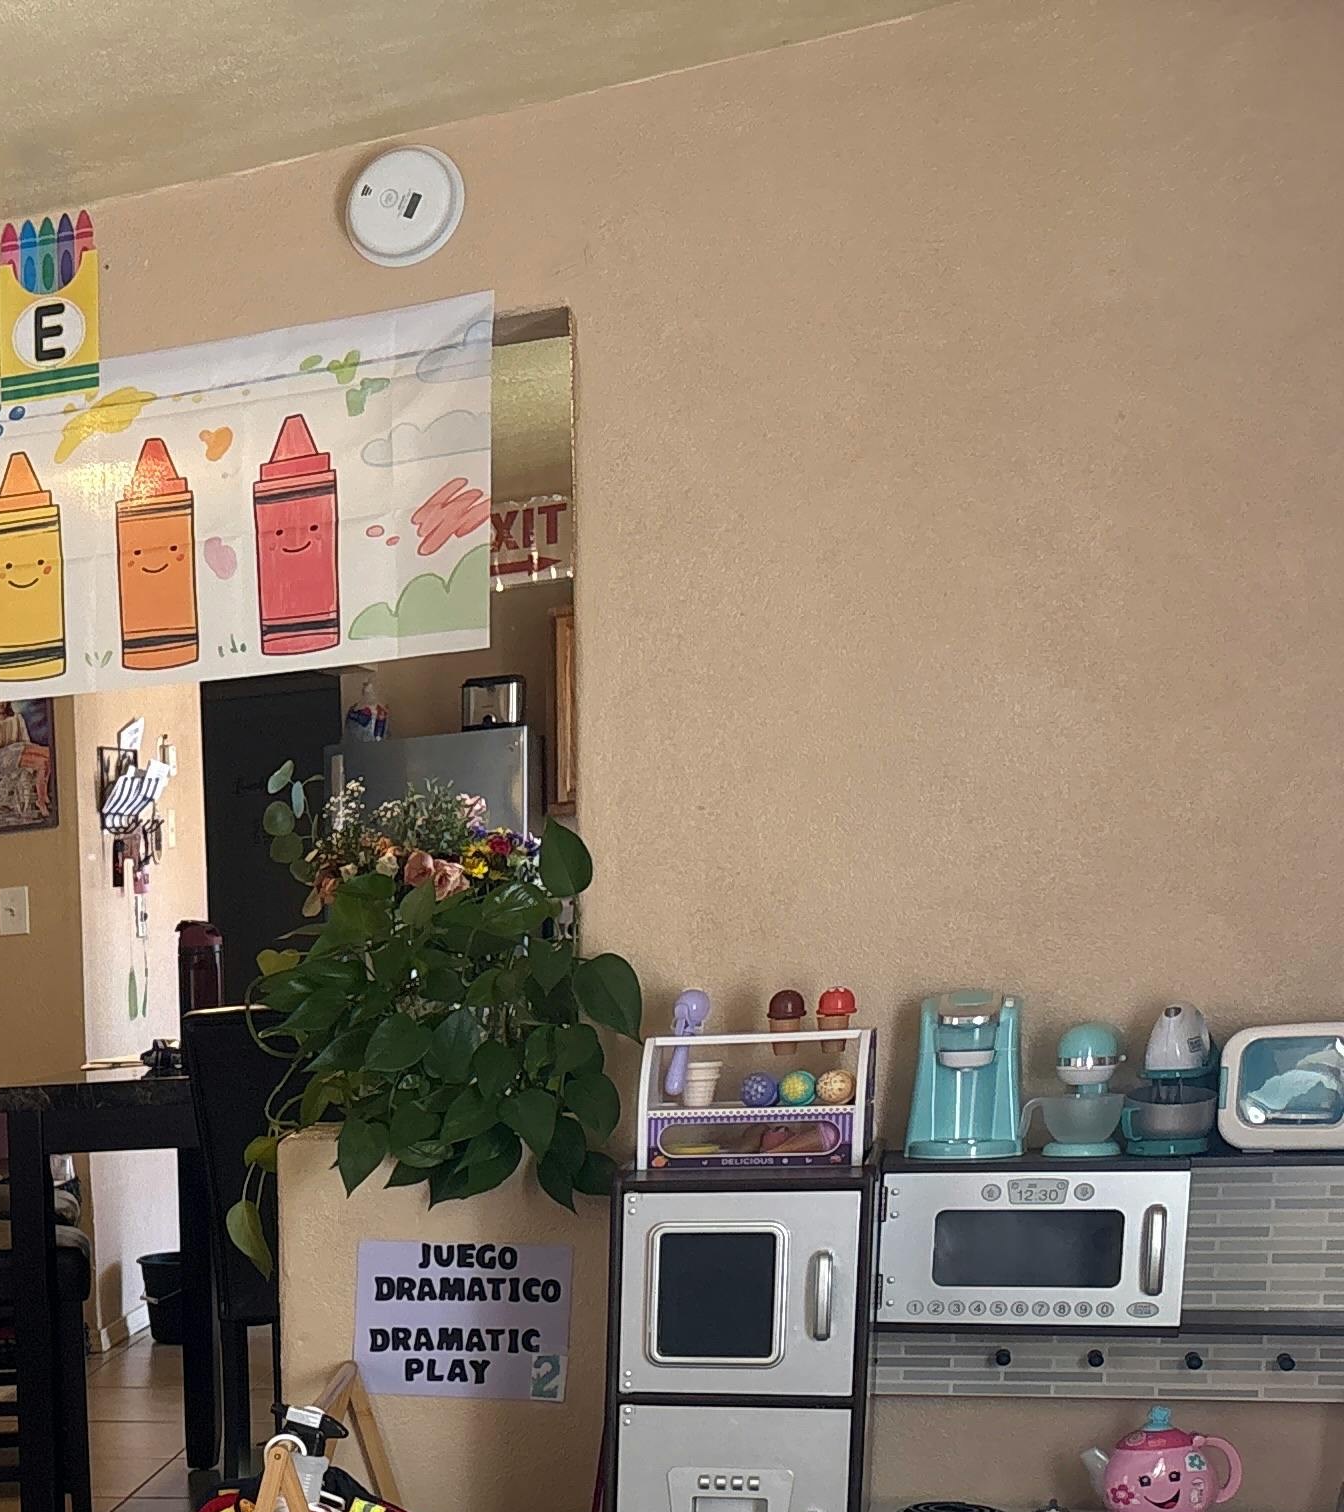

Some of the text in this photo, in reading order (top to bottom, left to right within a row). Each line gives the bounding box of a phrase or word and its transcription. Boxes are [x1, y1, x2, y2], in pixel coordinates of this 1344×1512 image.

[492, 503, 567, 552] XIT
[720, 1157, 774, 1166] DELICIOUS
[1016, 1188, 1060, 1202] 12:30
[418, 1242, 518, 1270] JUEGO
[374, 1276, 562, 1302] DRAMATICO
[369, 1327, 541, 1354] DRAMATIC
[404, 1358, 491, 1384] PLAY
[531, 1354, 560, 1398] 2
